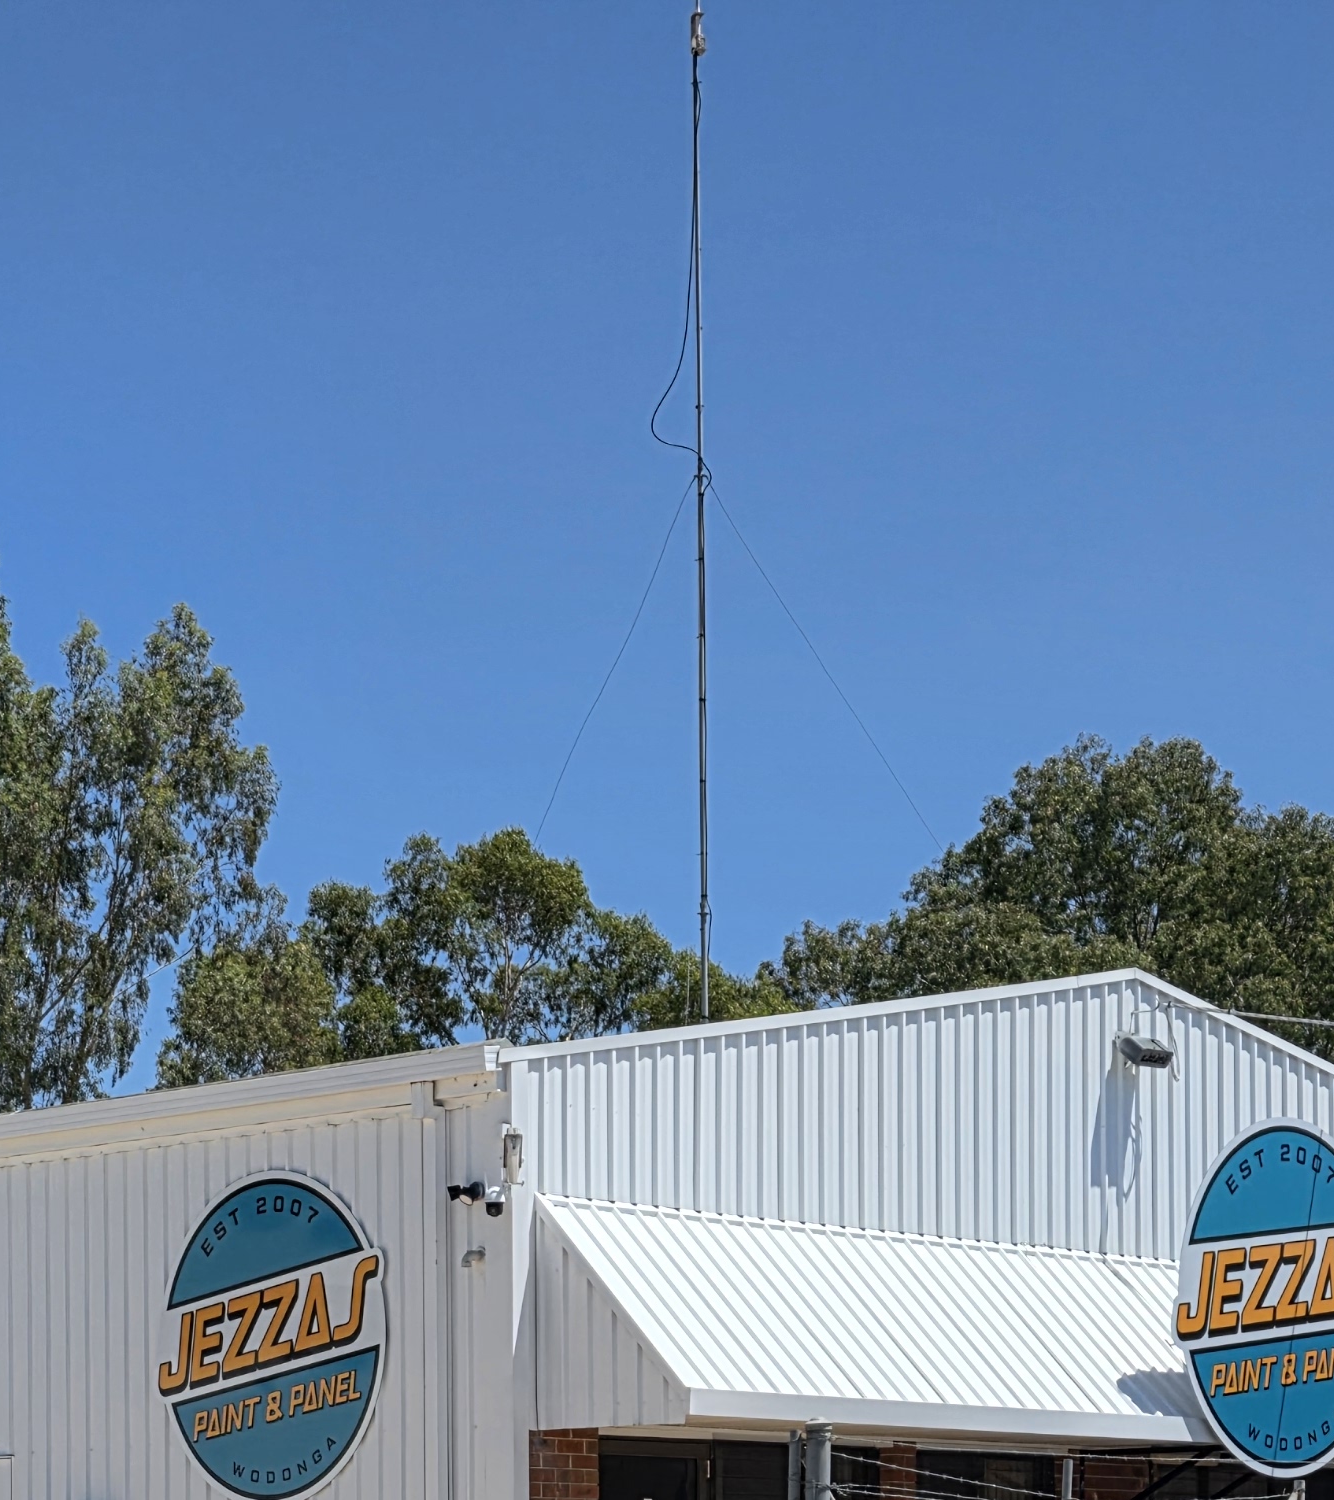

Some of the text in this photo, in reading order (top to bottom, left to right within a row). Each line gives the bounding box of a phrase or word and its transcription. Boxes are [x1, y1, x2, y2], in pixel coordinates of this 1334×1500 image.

[1225, 1147, 1266, 1196] EST
[200, 1195, 320, 1257] EST 2007
[158, 1254, 380, 1397] JEZZAS
[1210, 1355, 1278, 1398] PAINT
[1281, 1353, 1299, 1385] &
[192, 1370, 361, 1443] PAINT & PANEL
[233, 1436, 337, 1484] WODONGA
